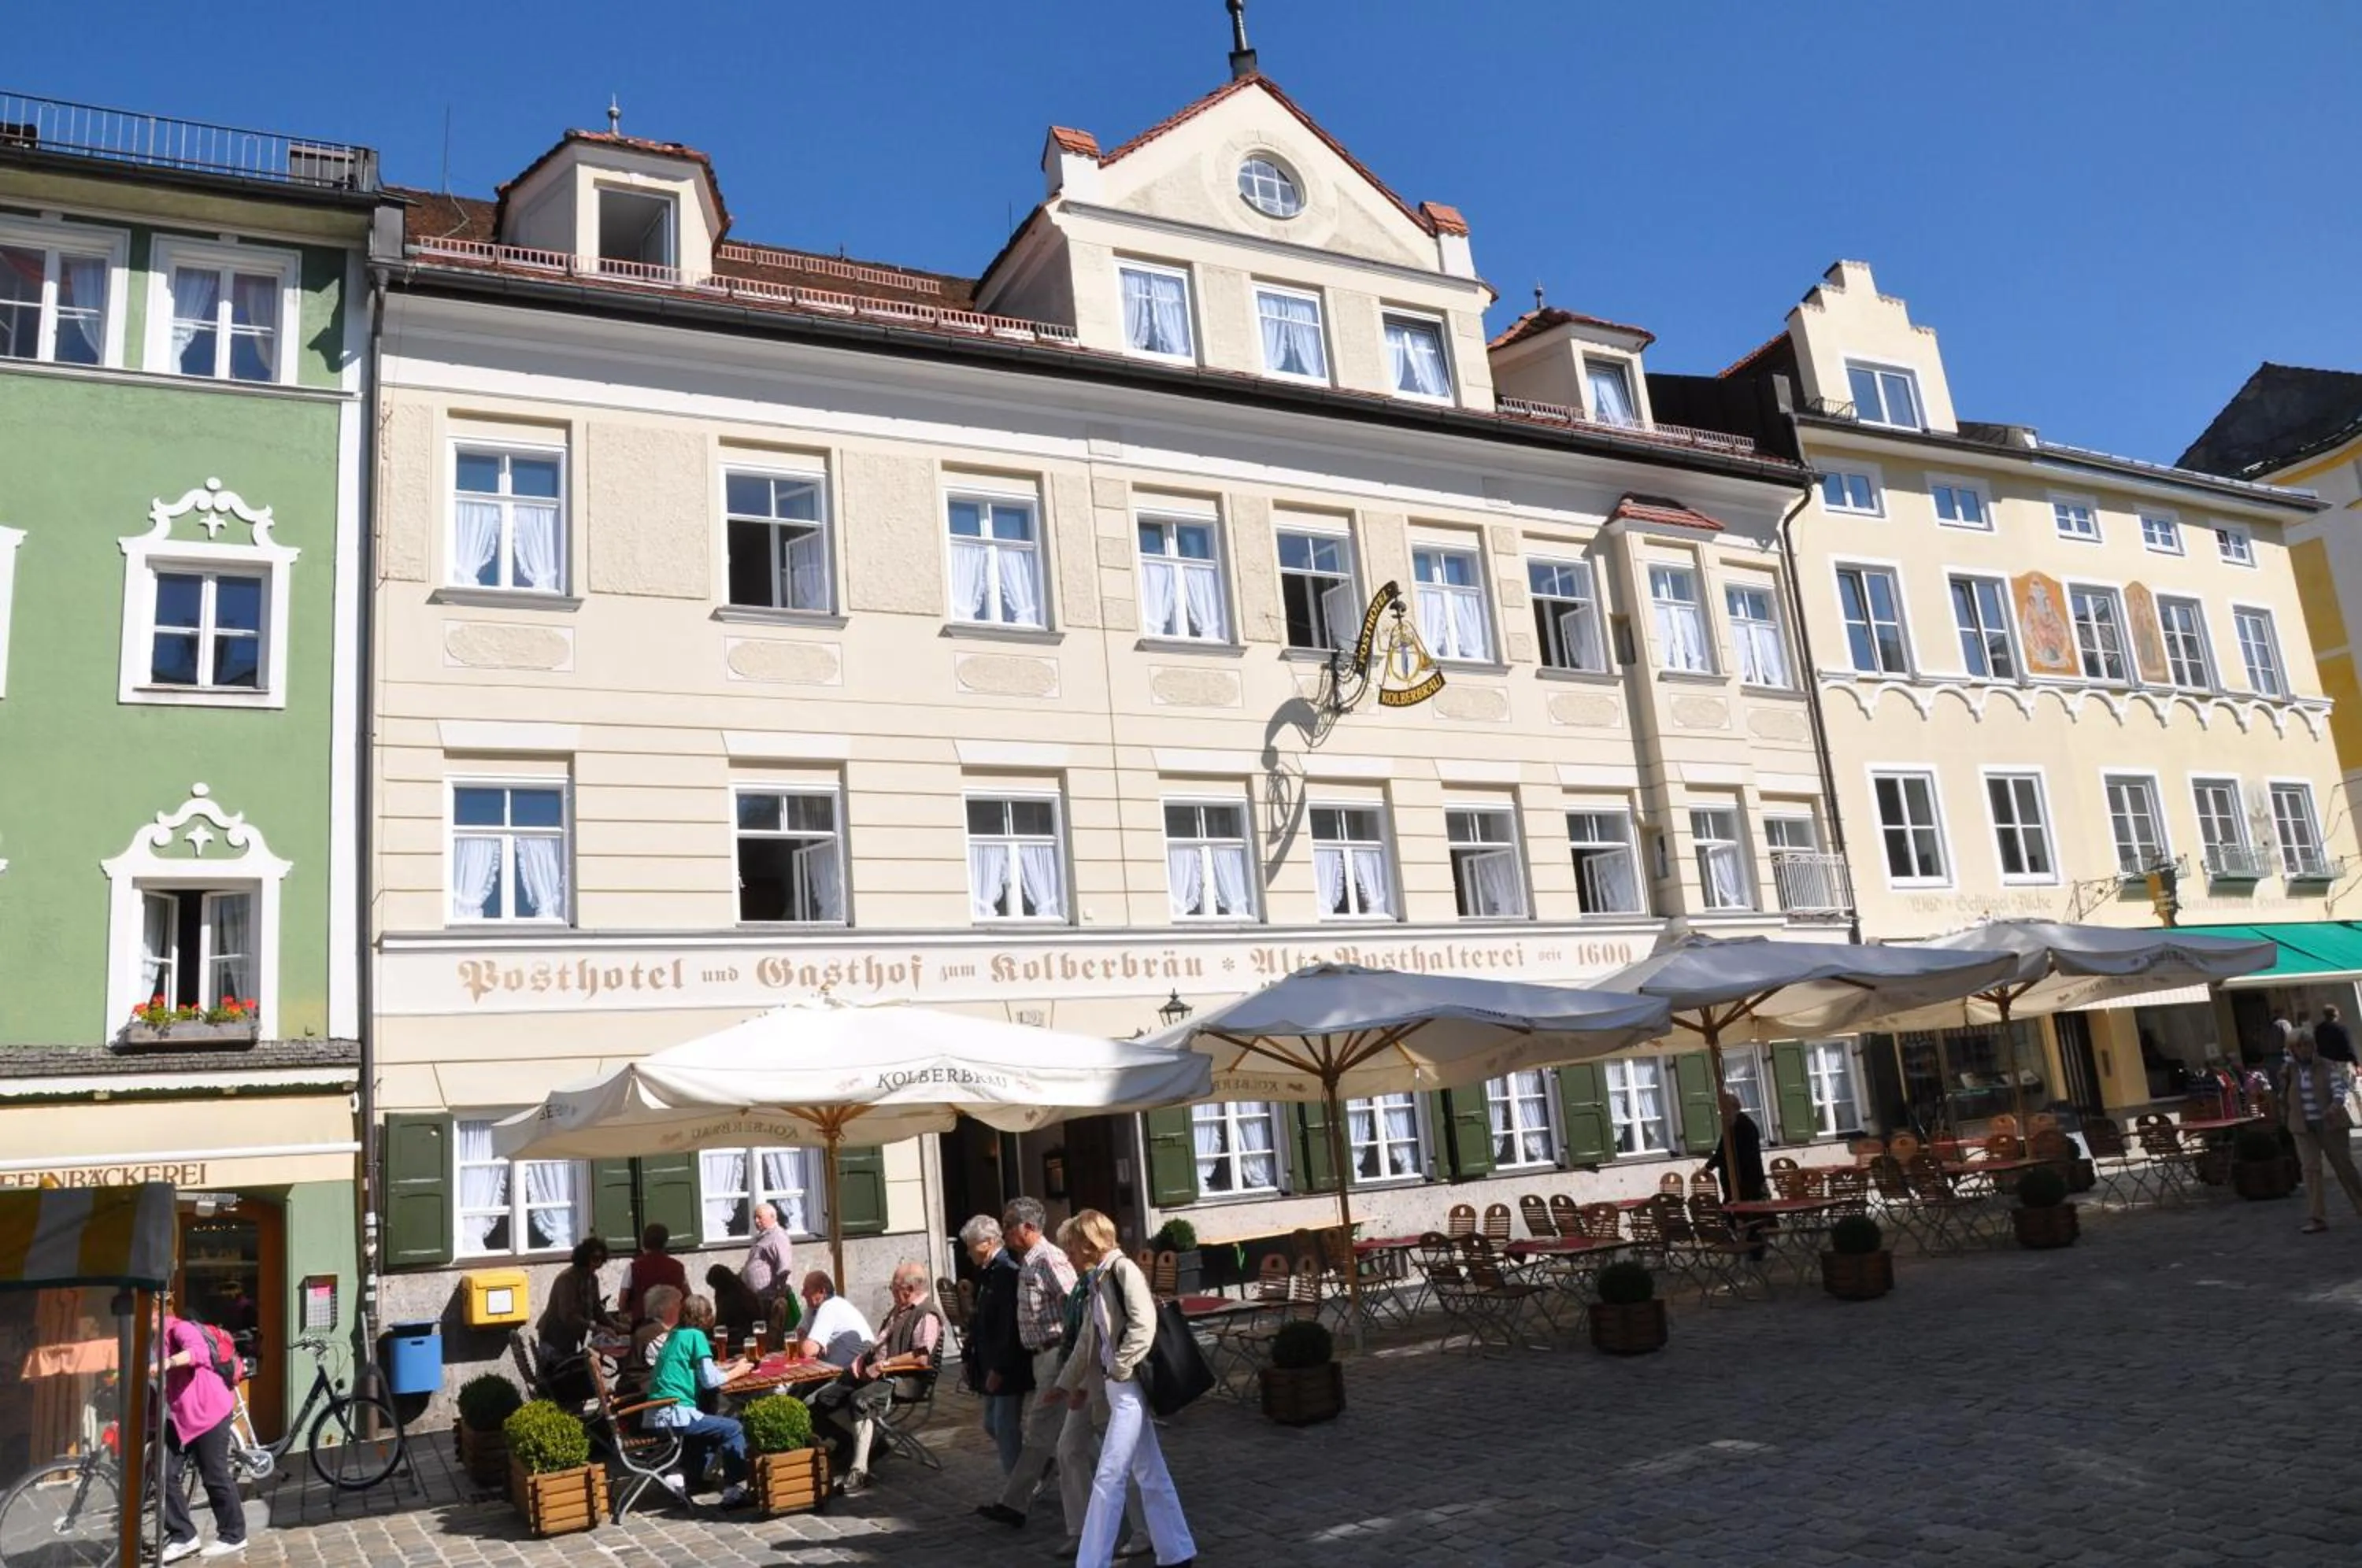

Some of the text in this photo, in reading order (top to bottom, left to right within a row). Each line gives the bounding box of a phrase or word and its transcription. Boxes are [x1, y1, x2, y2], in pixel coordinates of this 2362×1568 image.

[1357, 589, 1389, 666] POSTHOTEL
[458, 958, 685, 1004] Posthotel
[702, 966, 739, 982] und
[756, 955, 922, 993] Gasthof
[941, 964, 976, 982] zum
[990, 951, 1204, 982] Kolberbräu
[1538, 949, 1562, 962] seit
[1577, 943, 1632, 966] 1600
